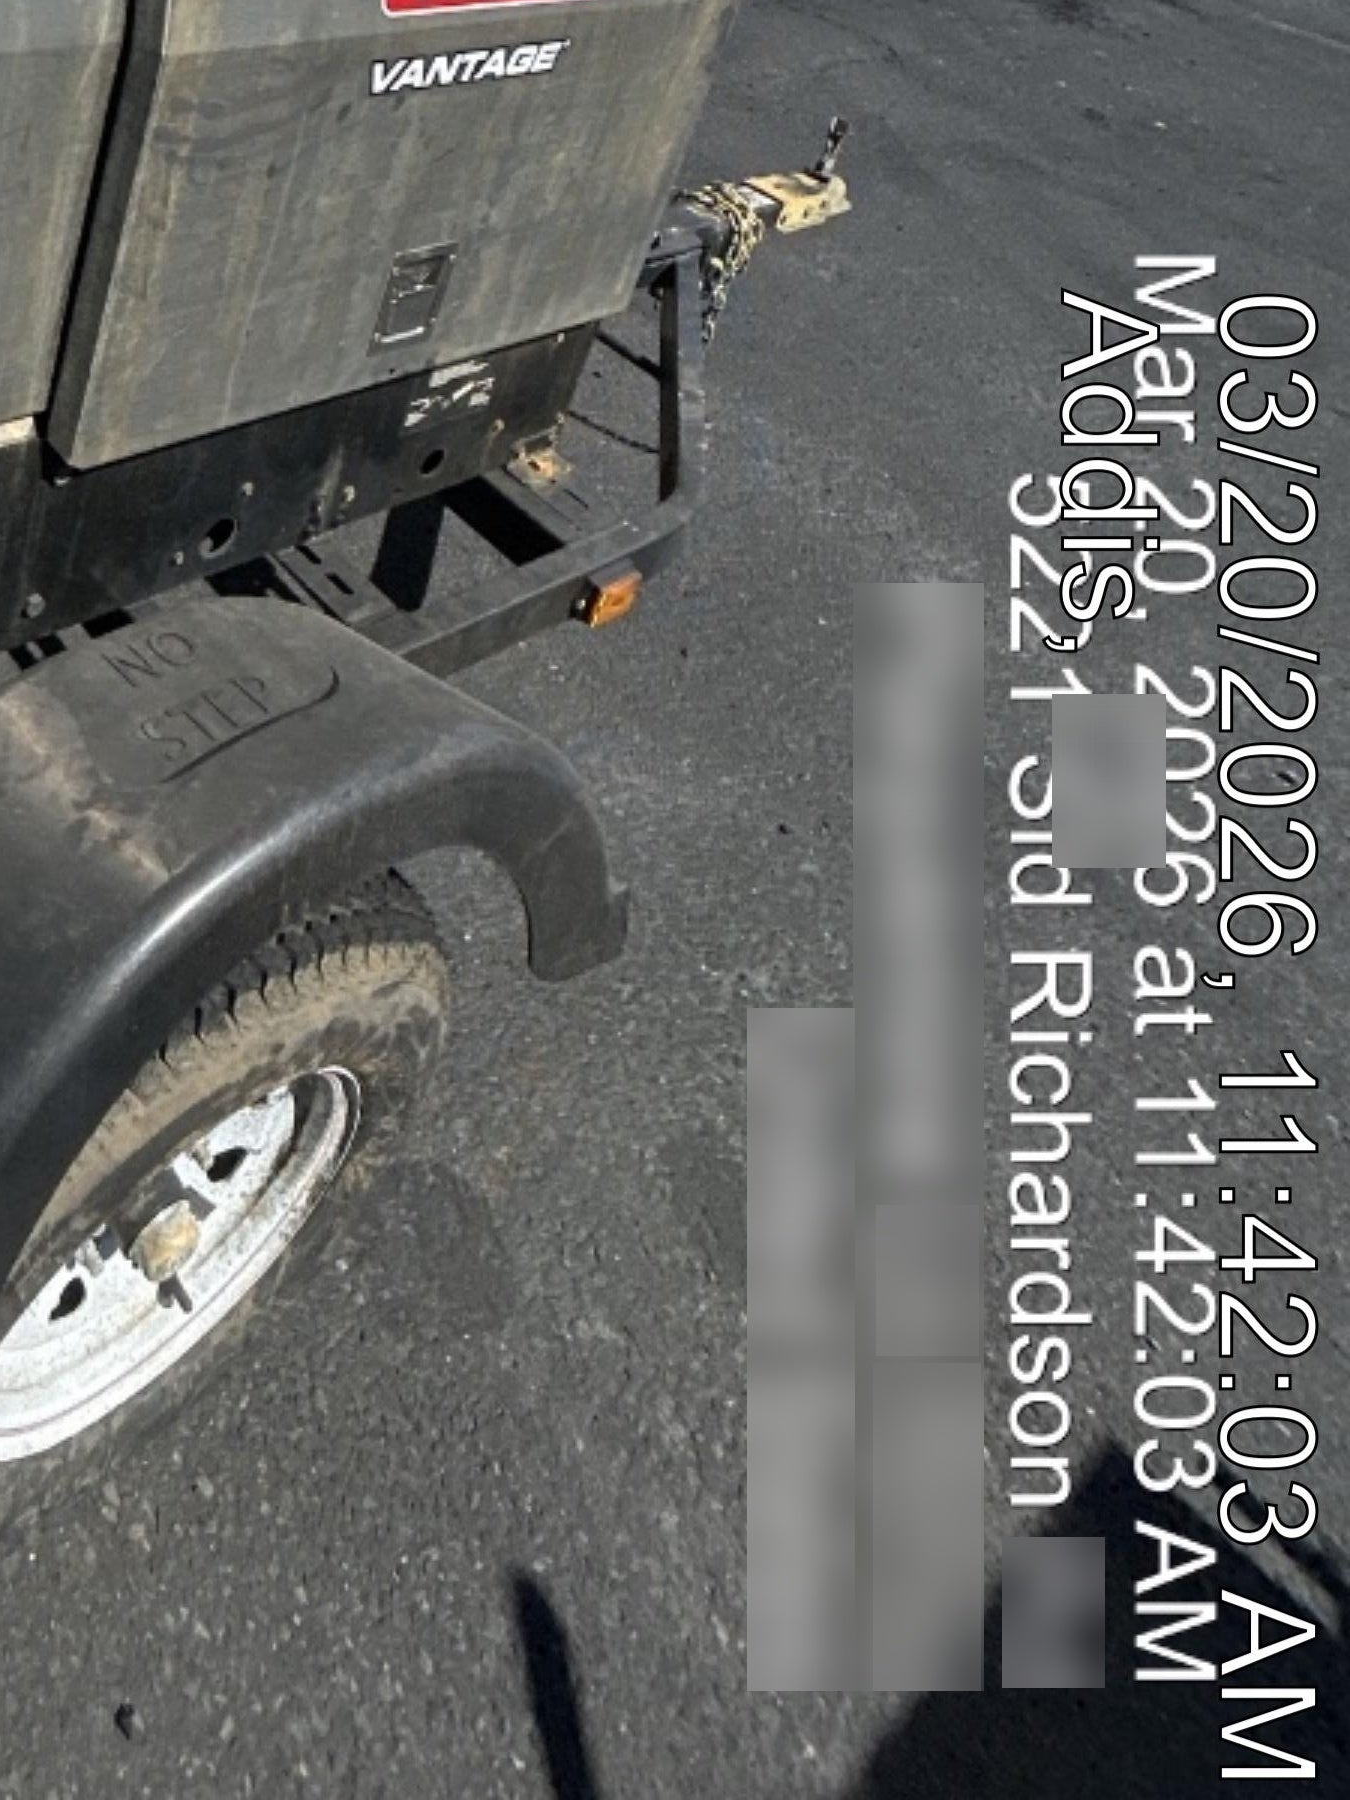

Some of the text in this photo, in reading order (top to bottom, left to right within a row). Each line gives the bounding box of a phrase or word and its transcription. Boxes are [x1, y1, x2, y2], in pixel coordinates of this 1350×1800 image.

[370, 40, 563, 95] VANTAGE
[100, 631, 197, 689] NO
[140, 676, 270, 761] STEP
